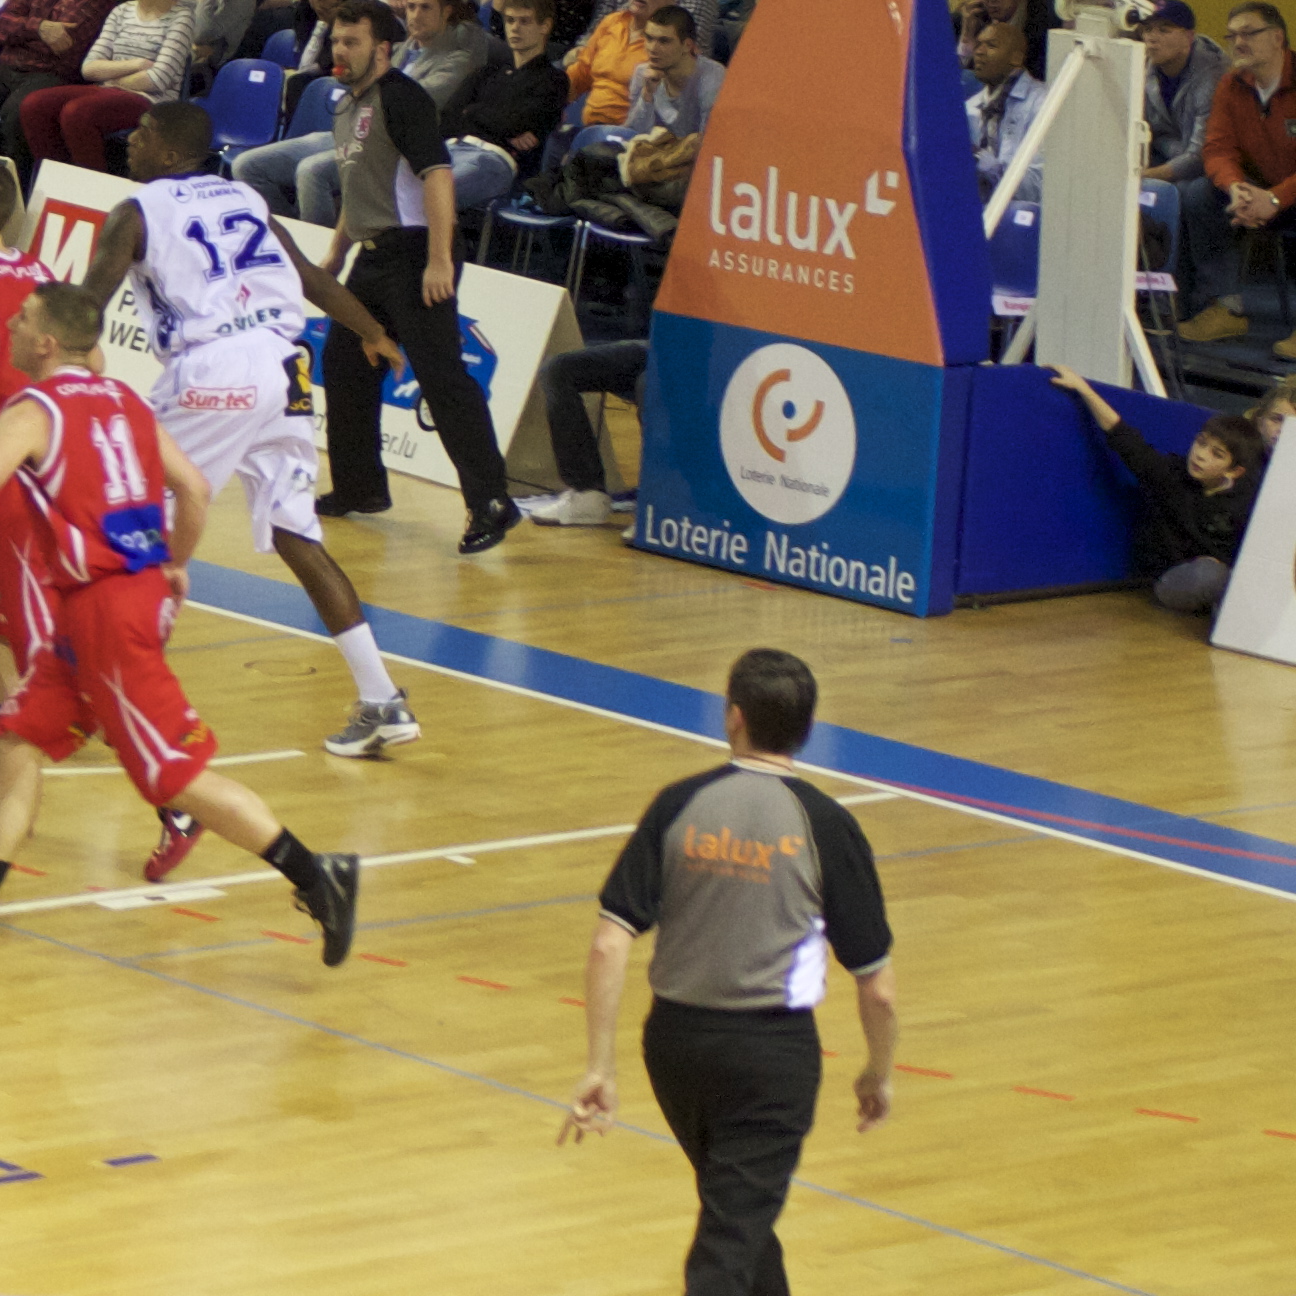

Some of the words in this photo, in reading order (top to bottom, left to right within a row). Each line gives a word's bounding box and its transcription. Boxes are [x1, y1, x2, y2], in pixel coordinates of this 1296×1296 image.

[710, 156, 856, 260] lalux
[184, 208, 286, 282] 12
[709, 248, 856, 295] ASSURANCES
[184, 388, 253, 409] Sun-tec
[90, 414, 148, 504] 11
[740, 465, 776, 485] Loterie
[780, 474, 830, 497] Nationale
[644, 504, 748, 565] Loterie
[765, 530, 916, 605] Nationale
[684, 823, 776, 872] lalux
